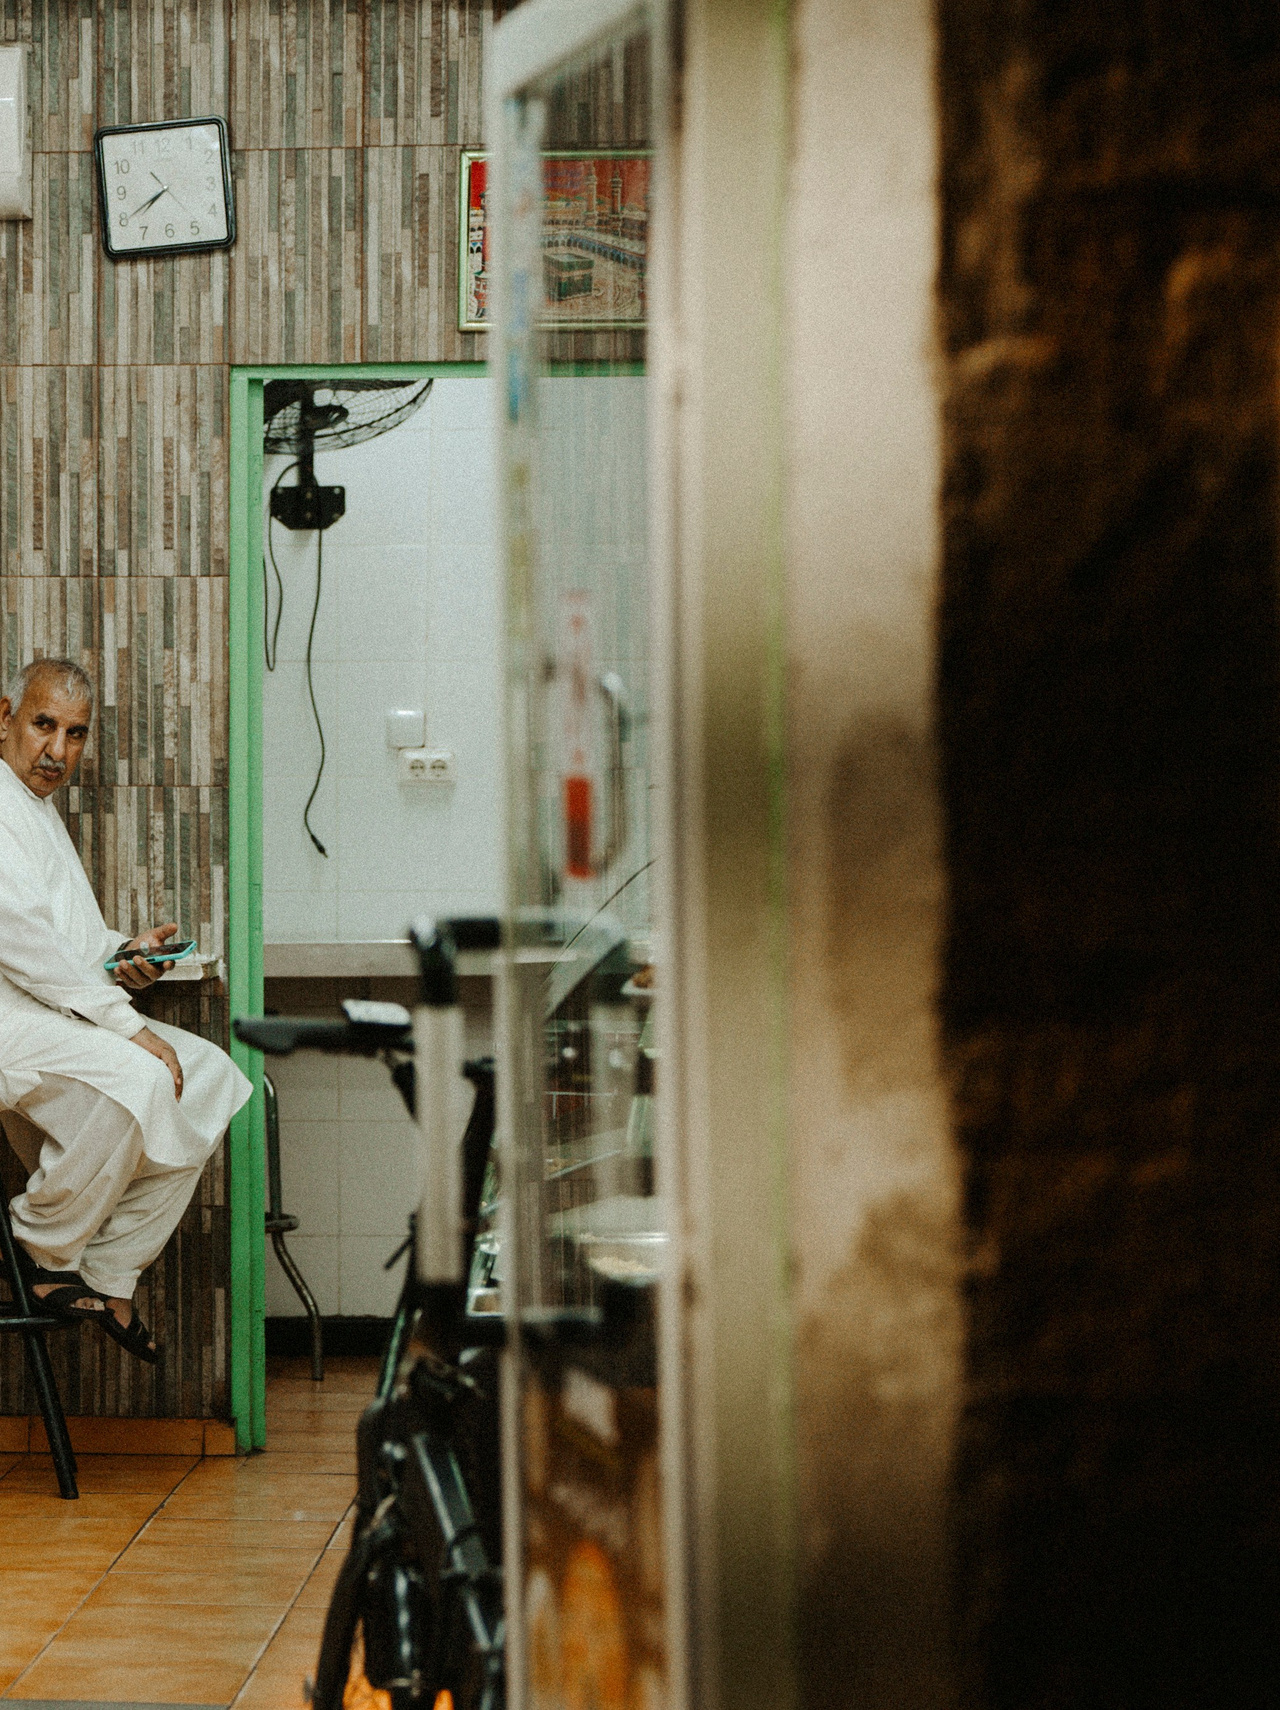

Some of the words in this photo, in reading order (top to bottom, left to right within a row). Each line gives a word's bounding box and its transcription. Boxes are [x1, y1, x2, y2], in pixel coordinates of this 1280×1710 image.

[132, 139, 145, 155] 11
[156, 137, 170, 154] 12
[205, 151, 215, 165] 2
[114, 158, 130, 175] 10
[206, 177, 216, 191] 3
[117, 185, 127, 200] 9
[208, 203, 217, 217] 4
[119, 212, 129, 227] 8
[139, 226, 149, 240] 7
[165, 223, 175, 238] 6
[190, 221, 200, 235] 5
